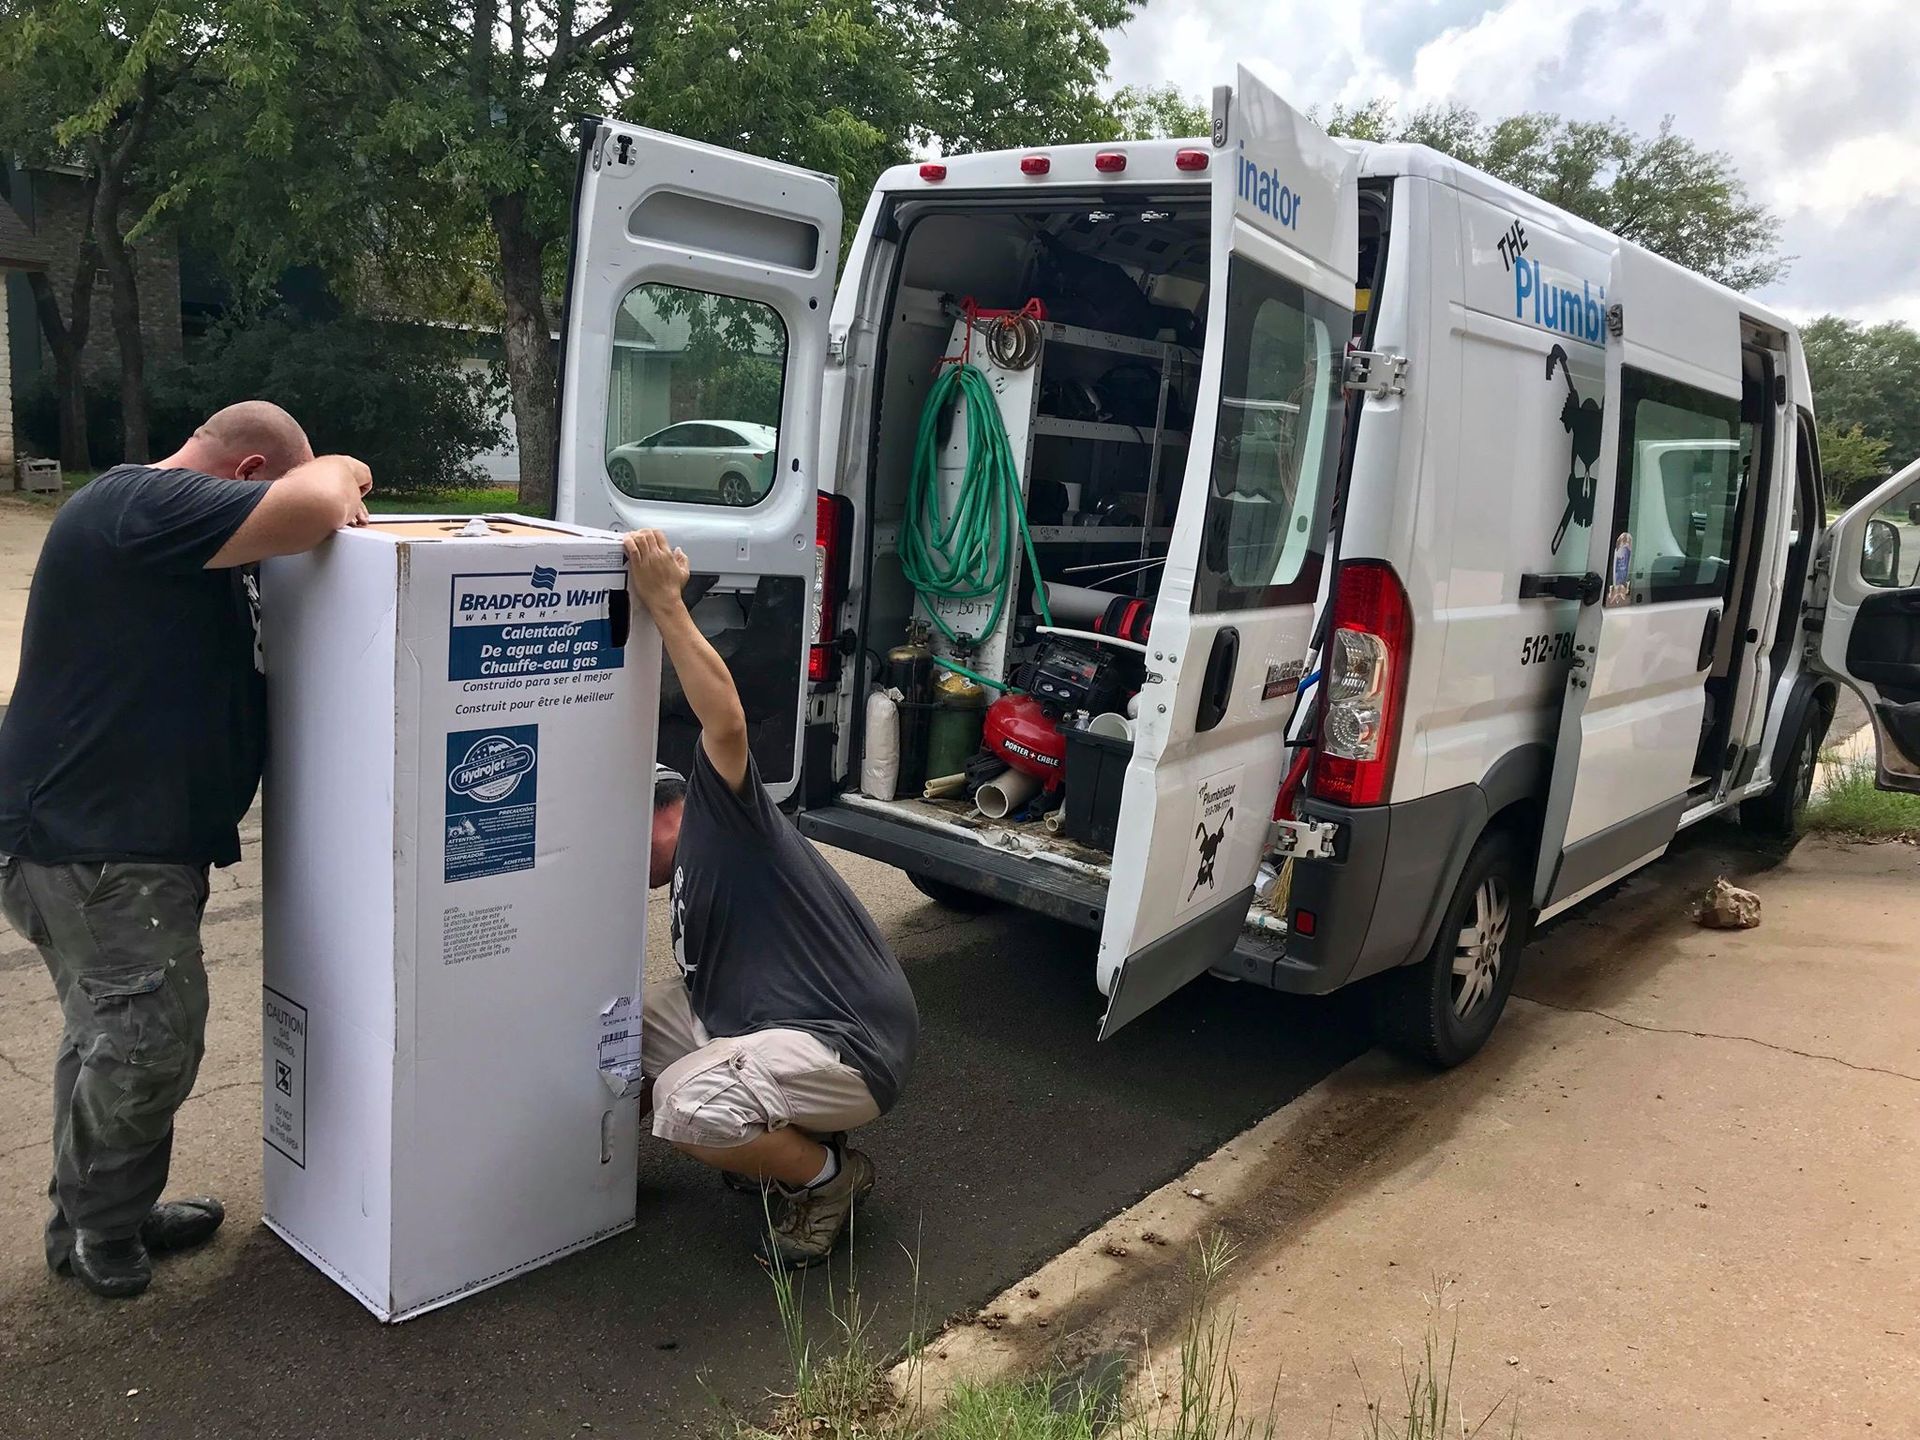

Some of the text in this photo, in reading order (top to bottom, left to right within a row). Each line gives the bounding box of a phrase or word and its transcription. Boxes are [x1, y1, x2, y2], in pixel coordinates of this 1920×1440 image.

[1238, 139, 1301, 231] inator
[1497, 219, 1529, 273] THE
[1515, 255, 1606, 345] Plumbi
[459, 589, 610, 612] BRADFORD WHIT
[465, 611, 525, 621] WATER
[501, 623, 582, 640] Calentador
[480, 640, 599, 659] De agua del gas
[480, 656, 598, 675] Chauffe-eau gas
[463, 671, 613, 693] Construido para ser el mejor
[455, 691, 616, 715] Construit pour être le Meilleur
[1004, 740, 1059, 767] PORTER CABLE
[266, 1002, 304, 1036] CAUTION
